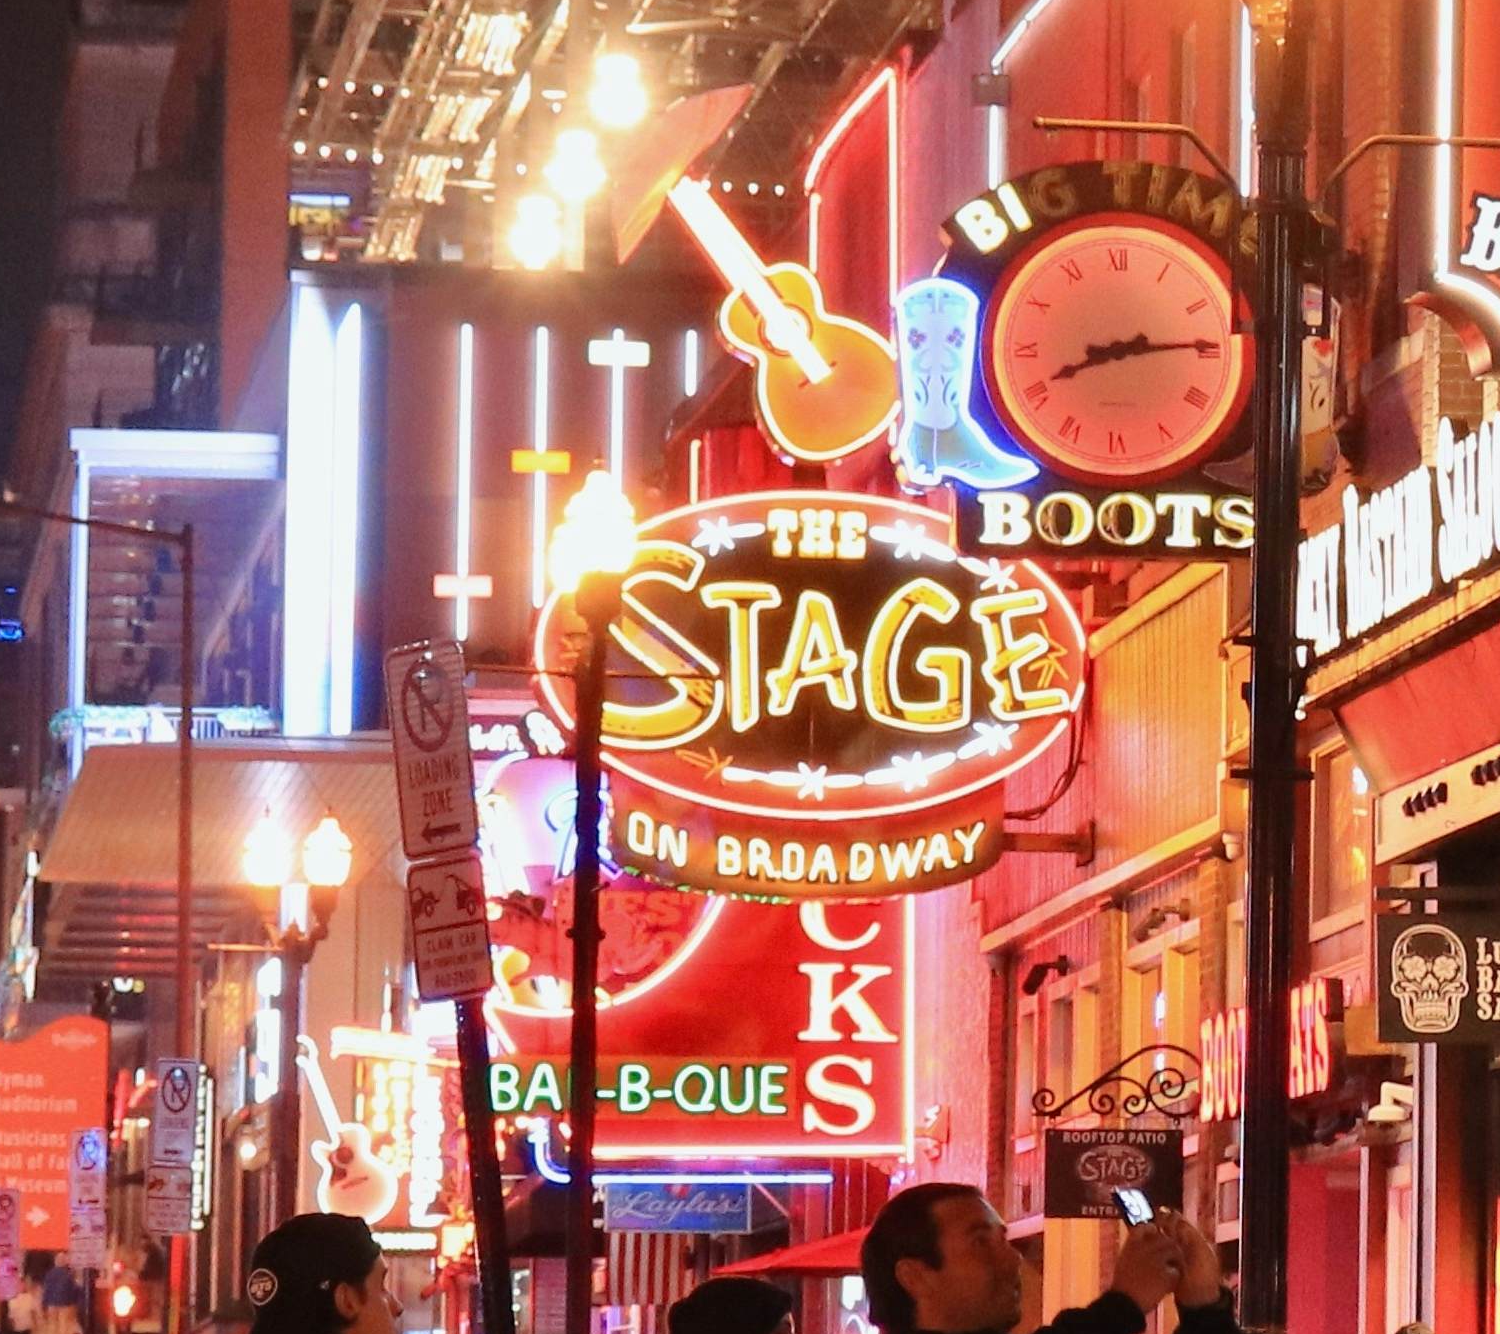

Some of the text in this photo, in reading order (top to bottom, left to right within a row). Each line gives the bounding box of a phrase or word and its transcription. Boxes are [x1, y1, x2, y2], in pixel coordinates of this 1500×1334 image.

[955, 172, 1077, 255] BIG
[766, 508, 868, 559] THE
[976, 490, 1256, 549] BOOTS
[597, 539, 1070, 750] STAGE
[408, 758, 462, 791] LOADING
[421, 787, 454, 817] ZONE
[626, 810, 986, 883] ON BROADWAY
[489, 1064, 788, 1113] BA-B-QUE
[1062, 1131, 1167, 1145] ROOFTOP PATIO
[30, 1153, 45, 1170] of
[49, 1153, 68, 1170] Fa
[1078, 1150, 1149, 1182] STAGE
[4, 1176, 67, 1194] Museum
[611, 1190, 745, 1224] Layla's
